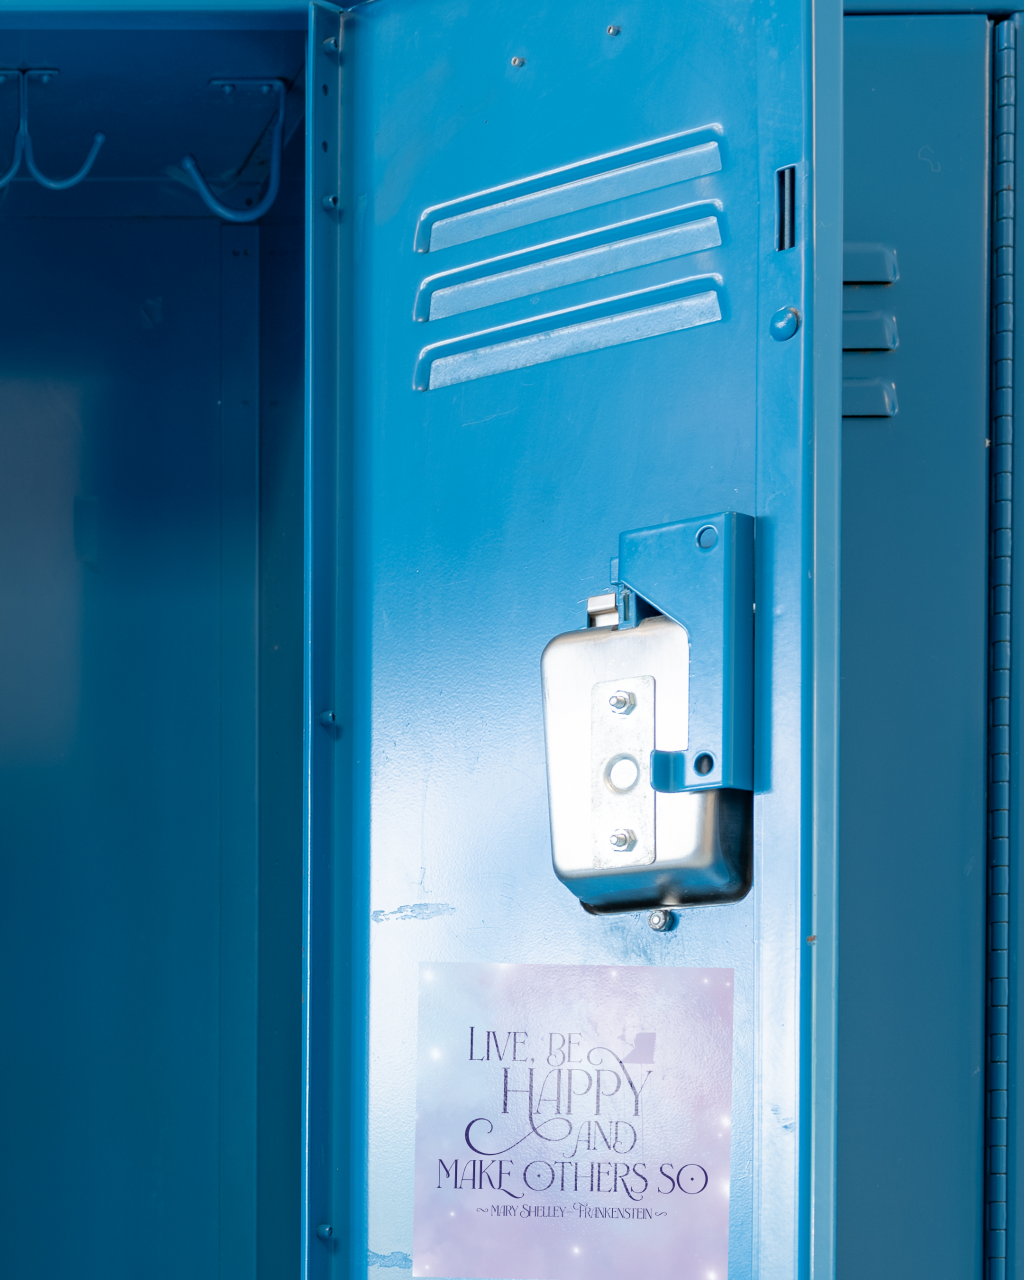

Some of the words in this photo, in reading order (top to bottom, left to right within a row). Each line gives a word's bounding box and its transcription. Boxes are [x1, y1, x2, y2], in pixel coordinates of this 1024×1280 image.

[468, 1026, 536, 1063] LIVE,
[546, 1032, 583, 1067] BE
[562, 1120, 638, 1159] AND
[436, 1158, 525, 1199] MAKE
[522, 1160, 649, 1202] OTHERS
[657, 1163, 710, 1195] SO
[490, 1203, 519, 1218] MARY
